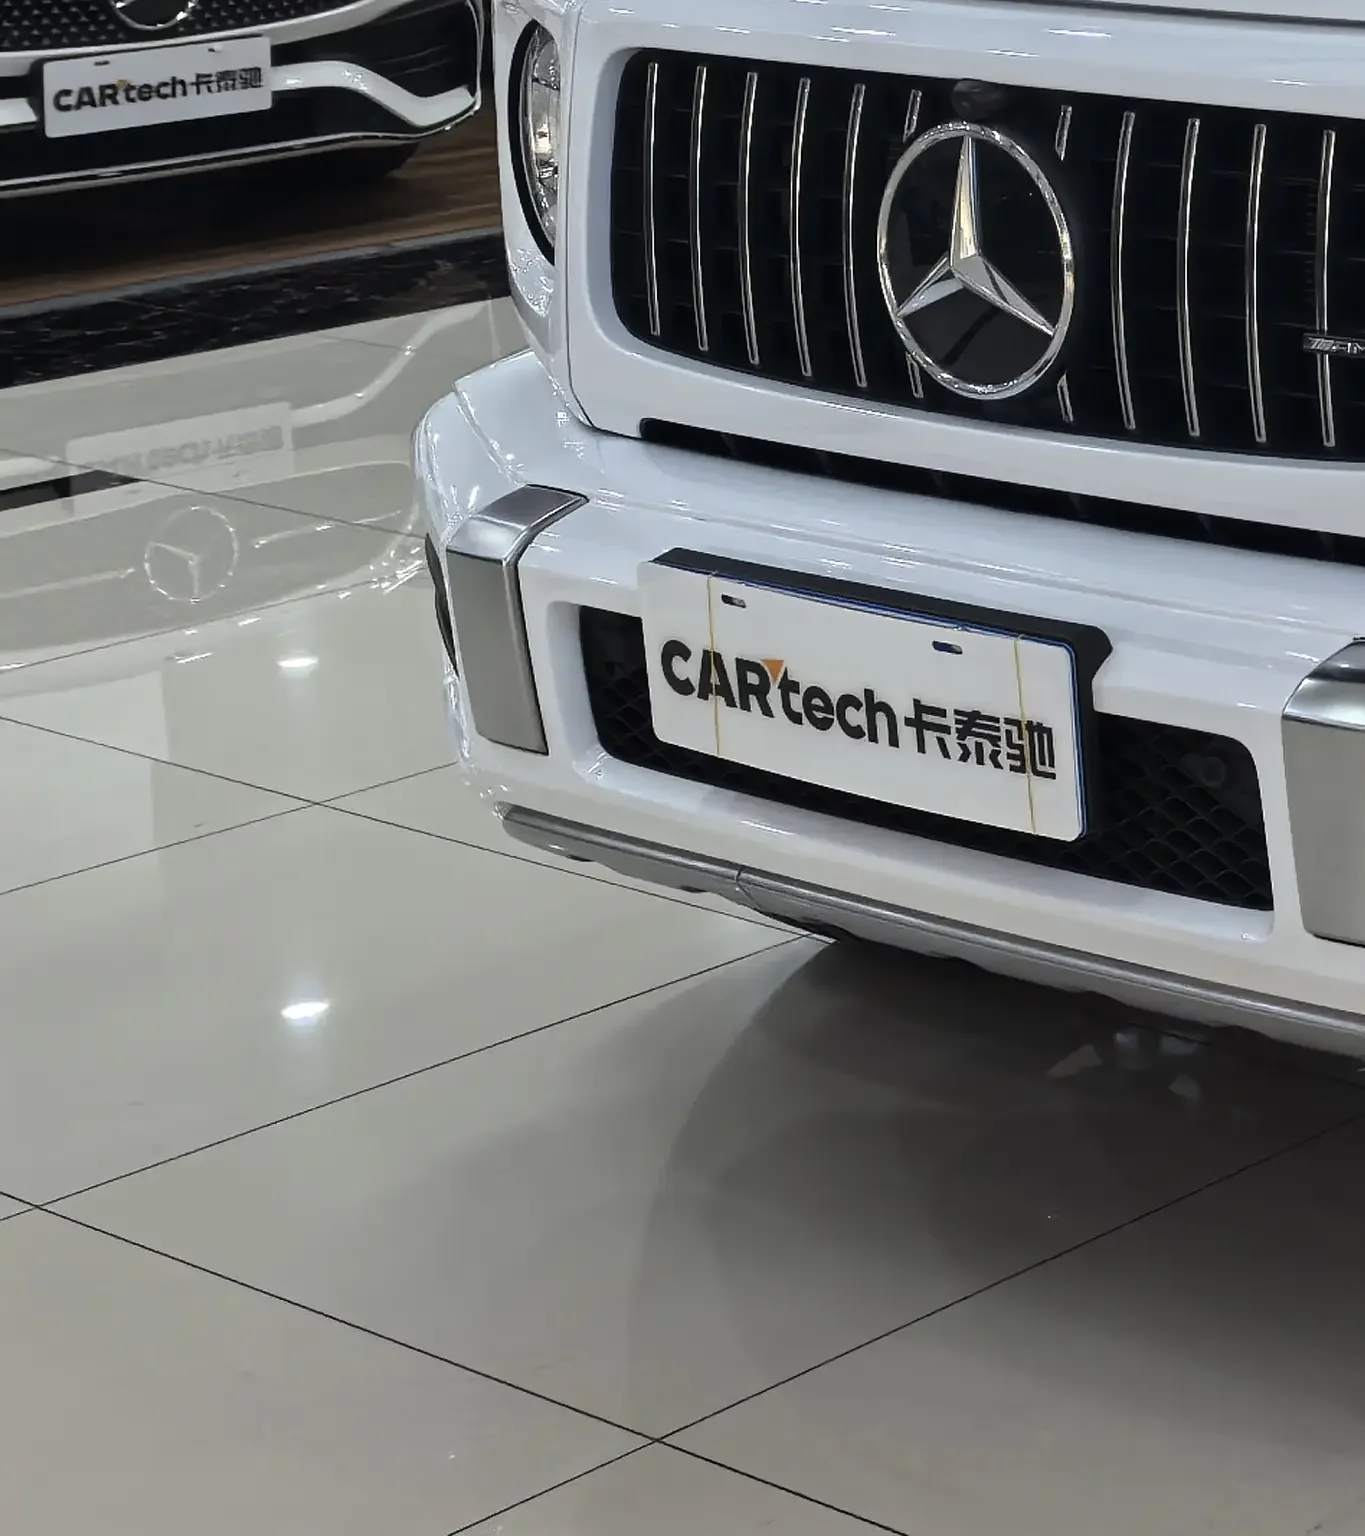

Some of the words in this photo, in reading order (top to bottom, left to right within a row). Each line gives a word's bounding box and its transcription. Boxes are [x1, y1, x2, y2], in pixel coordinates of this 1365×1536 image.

[53, 76, 187, 112] CARtech
[660, 639, 899, 748] CARtech
[904, 699, 1057, 780] 卡泰驰
